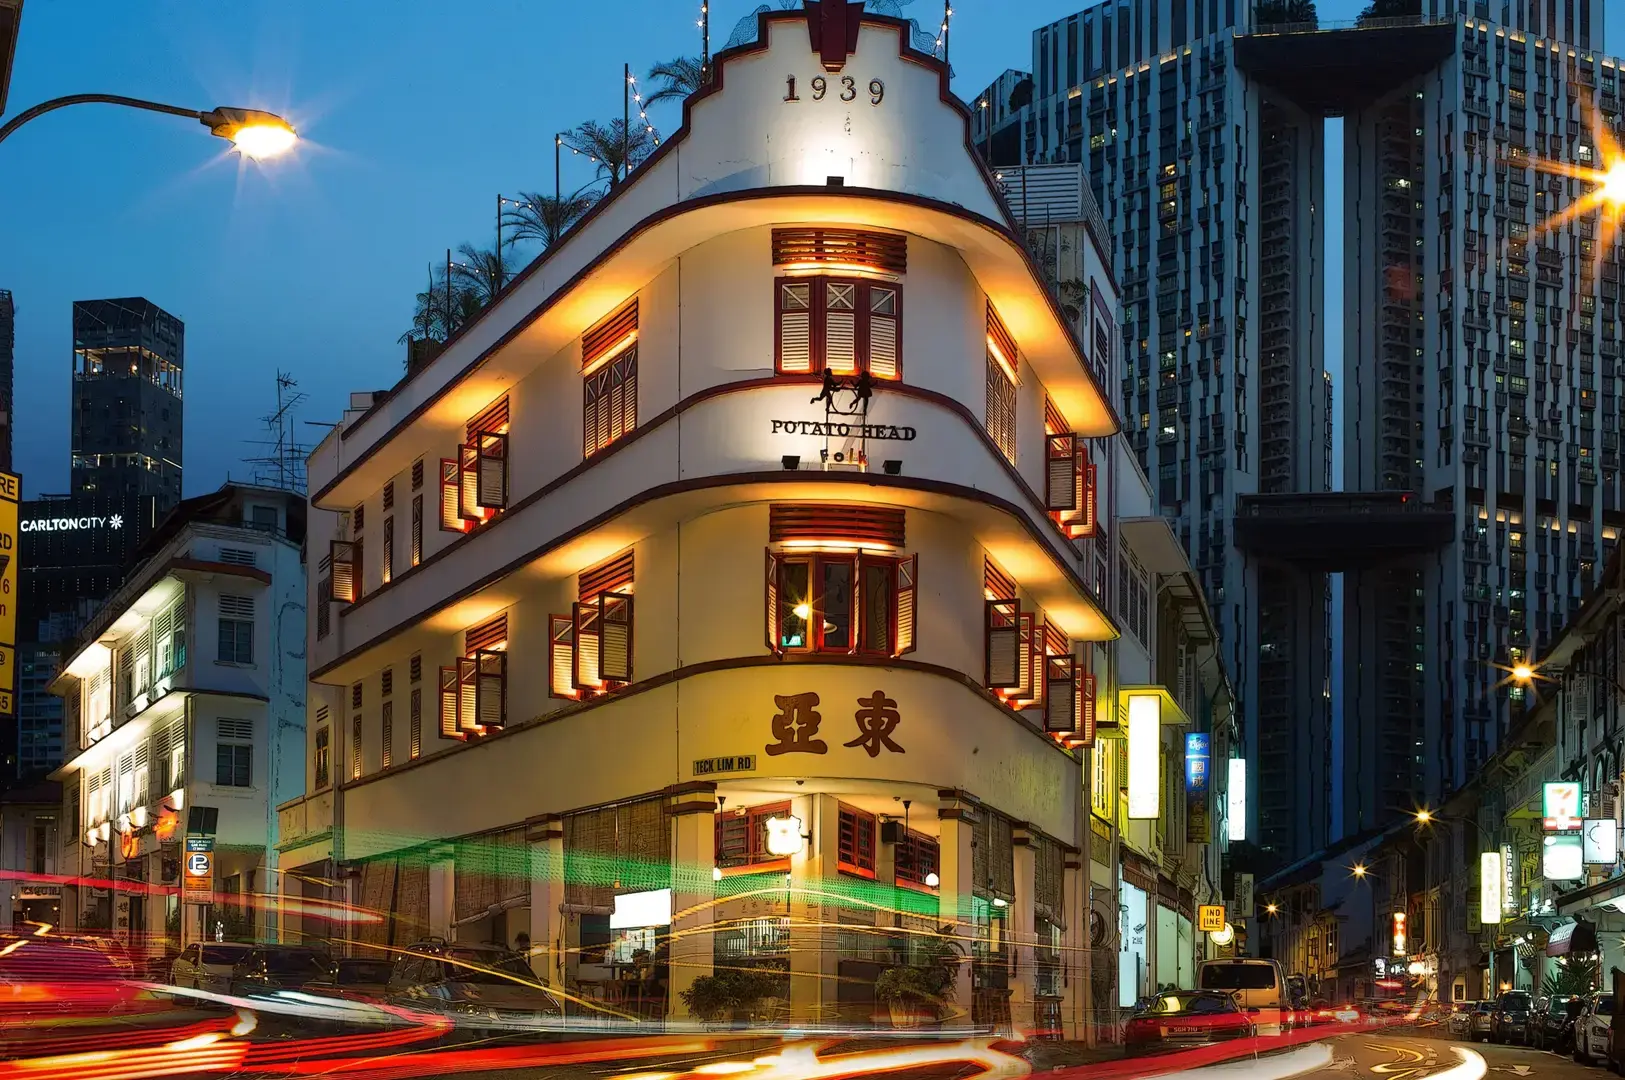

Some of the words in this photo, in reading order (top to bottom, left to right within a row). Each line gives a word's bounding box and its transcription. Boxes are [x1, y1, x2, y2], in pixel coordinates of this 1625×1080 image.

[783, 74, 885, 106] 1939
[771, 419, 850, 437] POTATO
[861, 424, 917, 441] HEAD
[695, 759, 714, 774] TECK
[717, 757, 734, 771] LIM
[738, 756, 751, 770] RD
